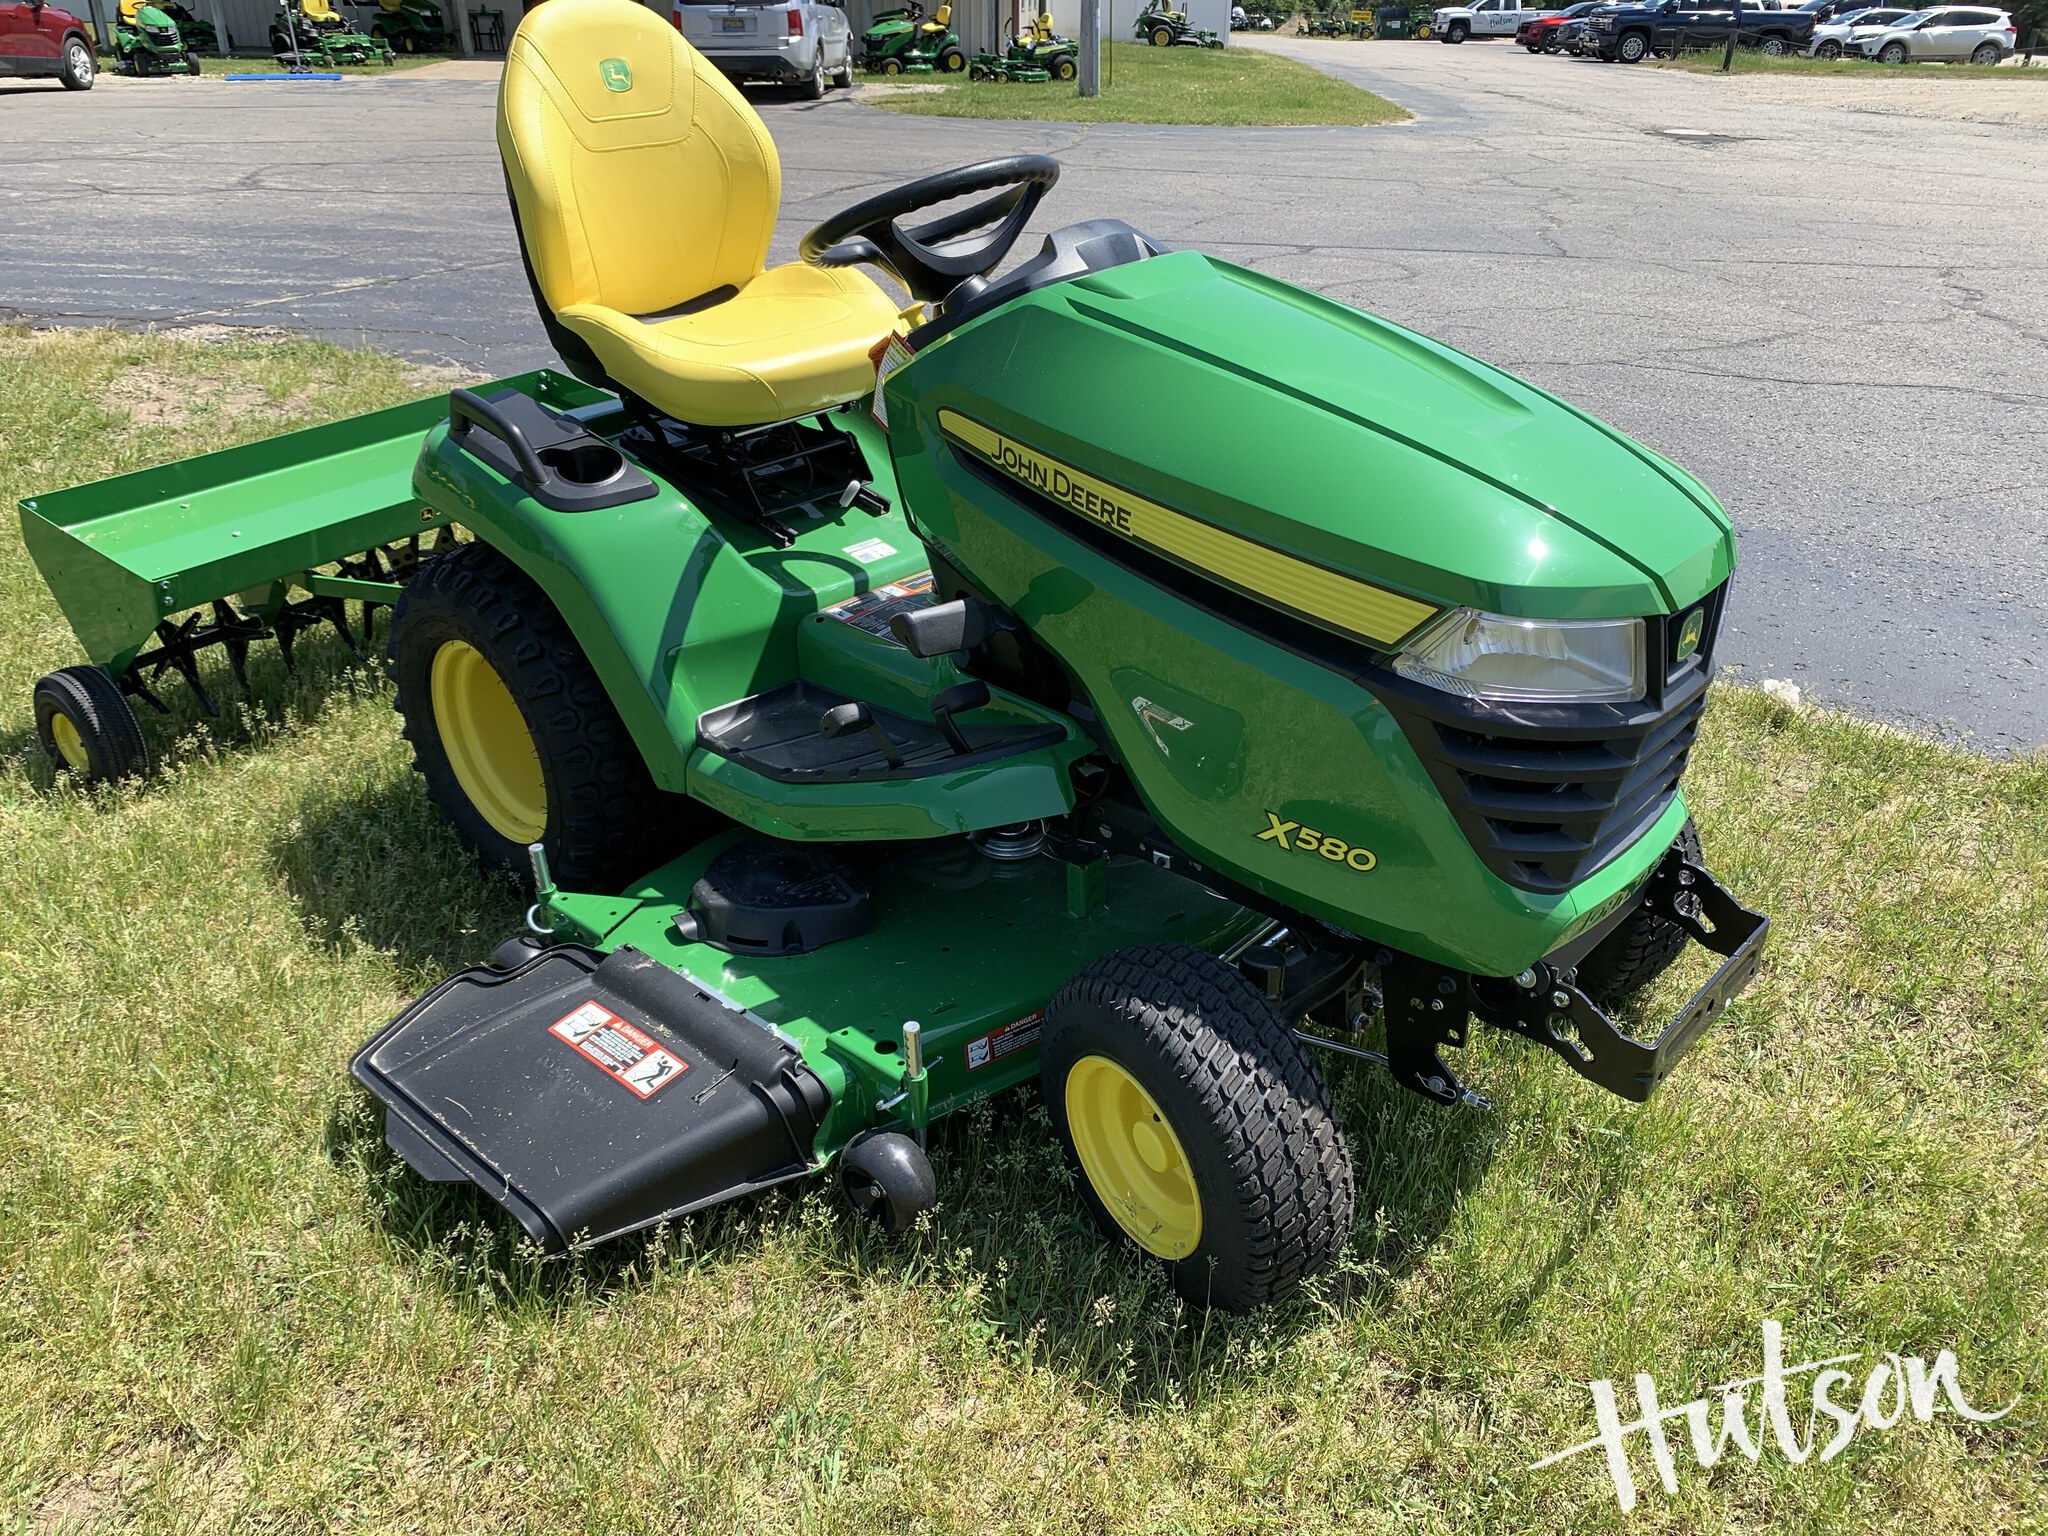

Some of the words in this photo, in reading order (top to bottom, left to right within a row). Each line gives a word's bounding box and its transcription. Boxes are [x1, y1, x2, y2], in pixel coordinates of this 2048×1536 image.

[1490, 16, 1514, 28] Hutson
[991, 437, 1048, 489] JOHN
[1053, 468, 1132, 533] DEERE
[1253, 809, 1378, 872] X580
[1010, 1013, 1037, 1029] DANGER
[621, 1024, 654, 1049] DANGER
